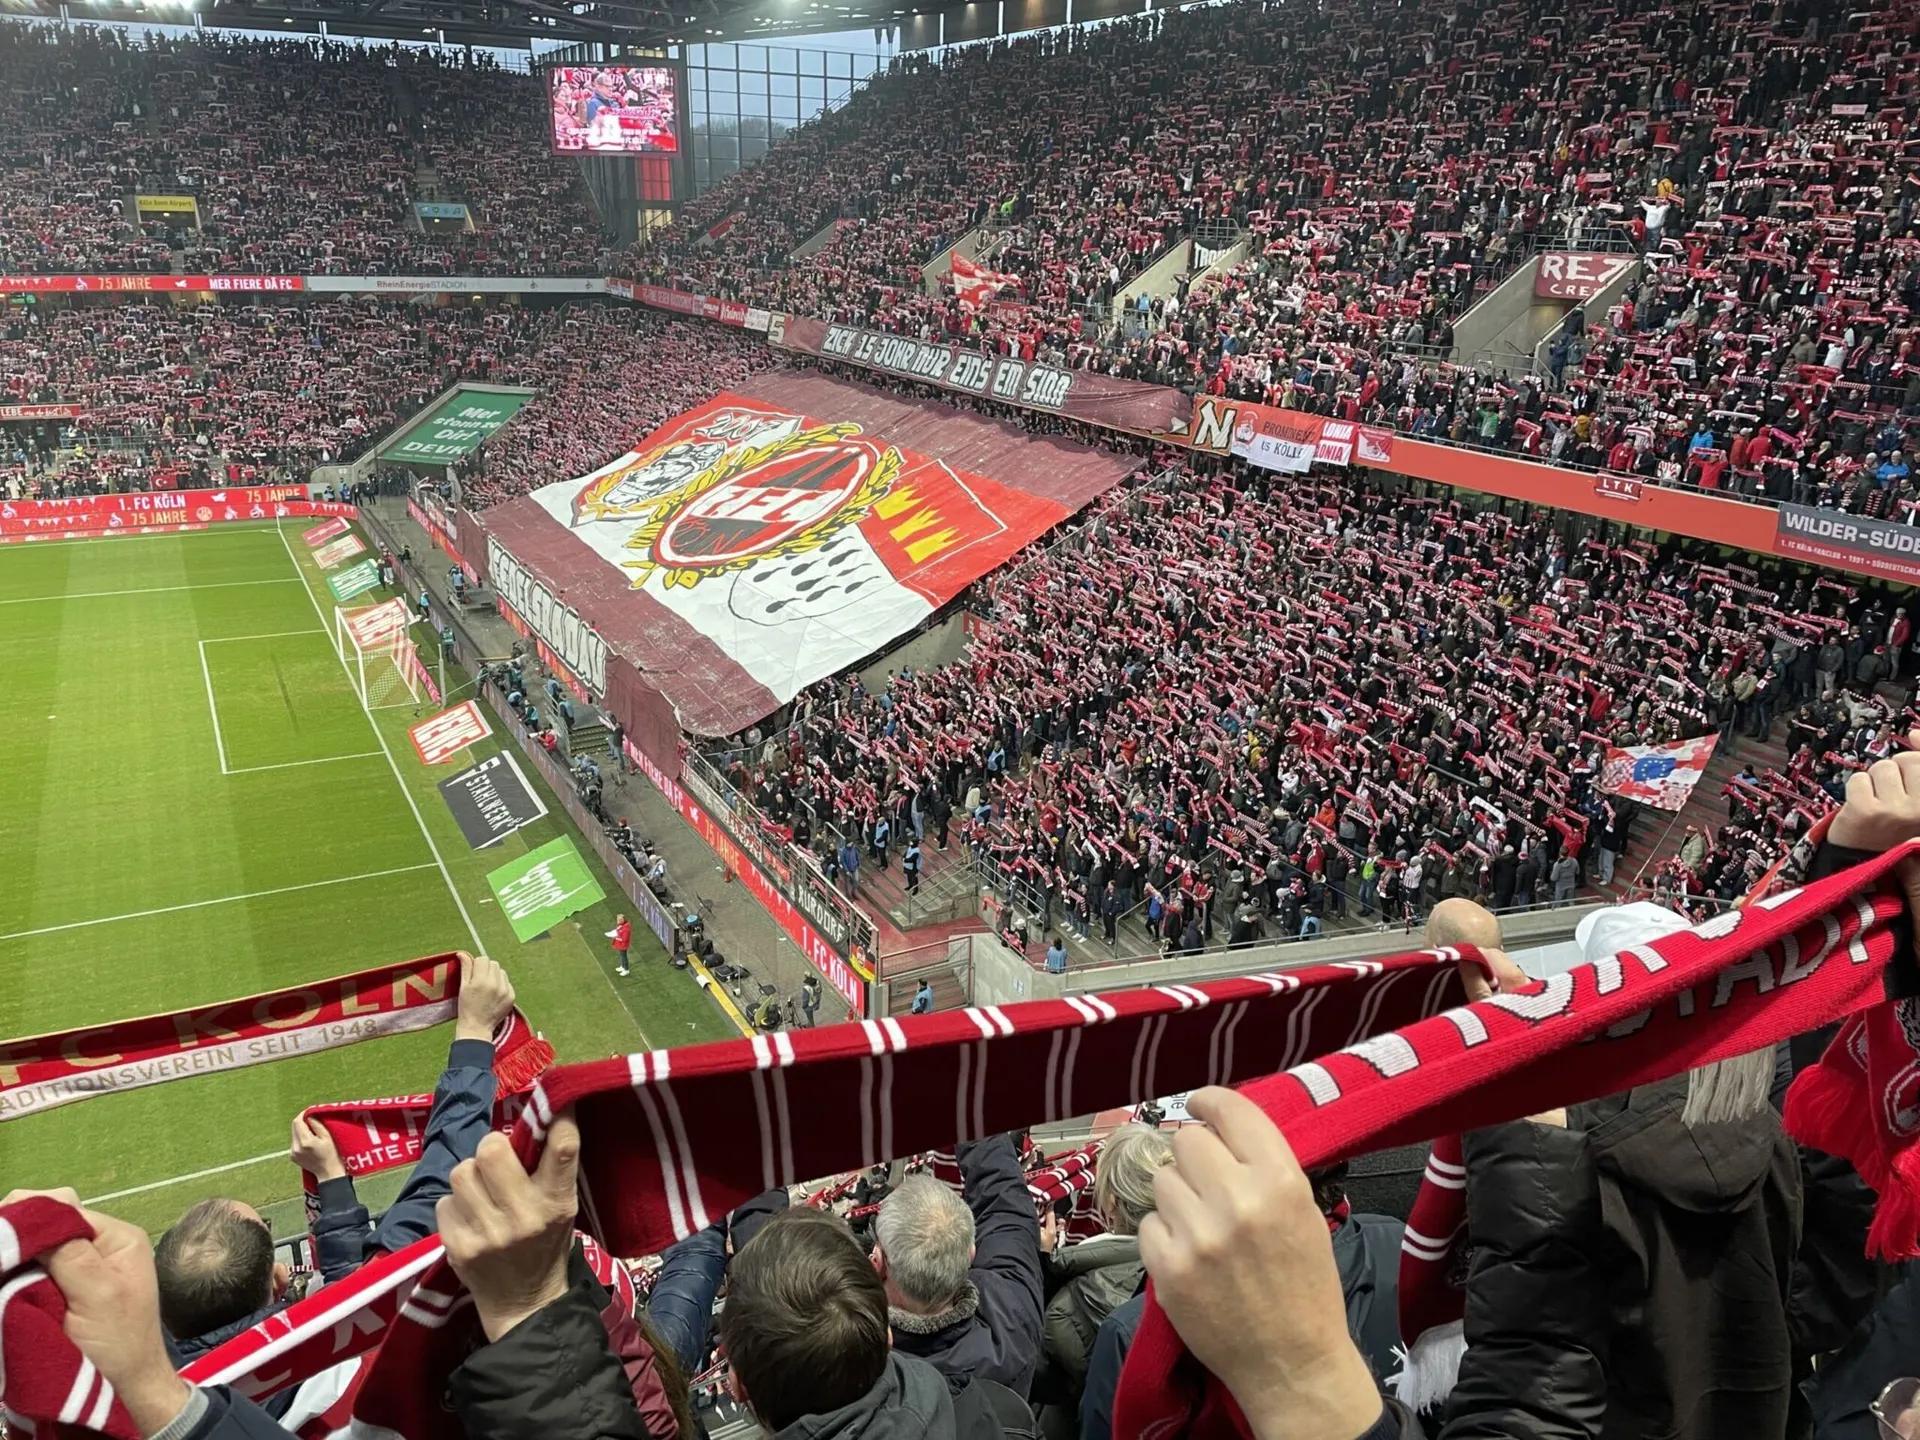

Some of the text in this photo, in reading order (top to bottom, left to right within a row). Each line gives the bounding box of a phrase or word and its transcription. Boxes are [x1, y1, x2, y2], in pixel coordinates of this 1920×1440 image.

[99, 278, 113, 289] 75
[117, 278, 152, 290] JAHRE
[209, 279, 231, 290] MER
[233, 278, 262, 290] FIERE
[280, 278, 293, 289] FC
[1550, 284, 1597, 297] CRE
[824, 326, 857, 356] ZICK
[950, 352, 993, 391] EINS
[459, 407, 500, 419] Mer
[403, 441, 469, 454] DEVK
[134, 496, 149, 510] FC
[154, 493, 186, 509] KÖLN
[246, 490, 261, 503] 75
[131, 510, 187, 526] 75 JAHRE
[412, 702, 487, 760] REWE
[466, 770, 514, 831] STAHLWERK
[812, 939, 828, 971] FC
[829, 952, 858, 1007] KÖLN
[250, 1034, 303, 1058] SEIT
[318, 1018, 379, 1044] 1948
[346, 1144, 403, 1171] CHTE
